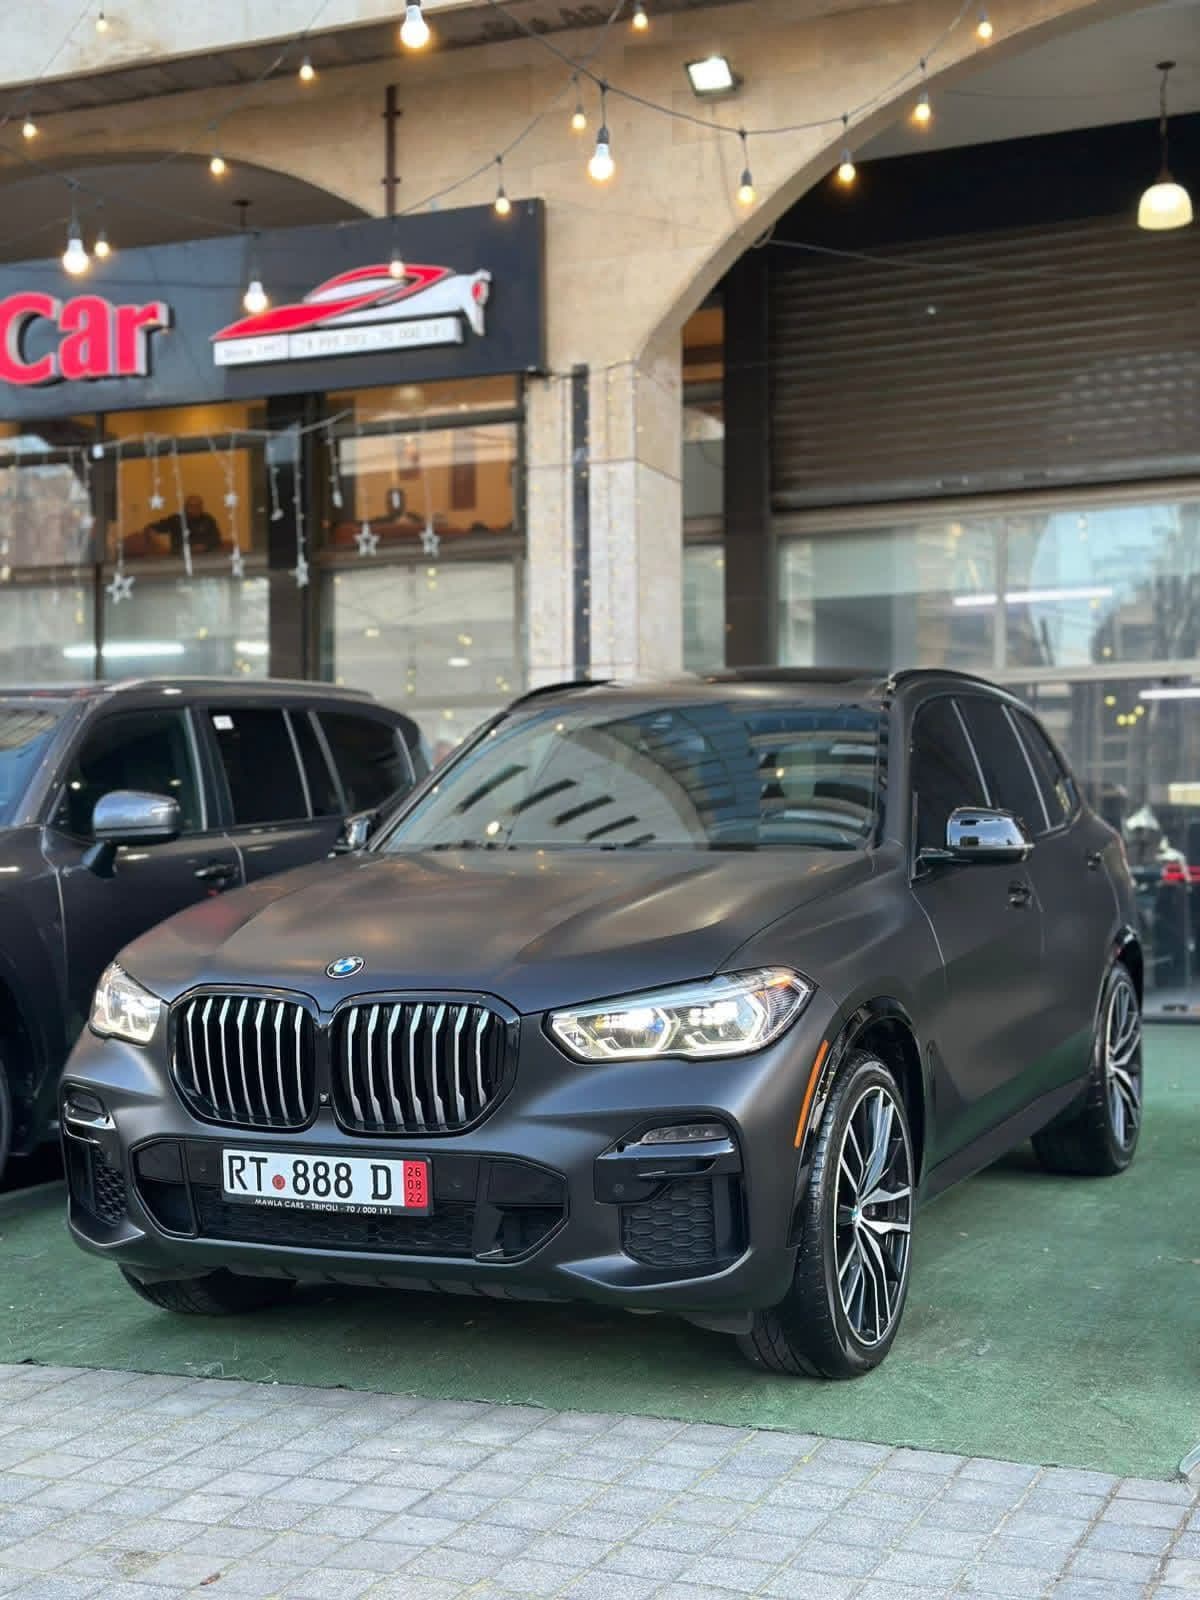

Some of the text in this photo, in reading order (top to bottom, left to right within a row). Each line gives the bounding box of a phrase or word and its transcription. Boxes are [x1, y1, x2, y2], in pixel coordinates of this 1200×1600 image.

[0, 291, 168, 385] Car
[227, 1155, 392, 1201] RT 888 D
[407, 1166, 422, 1178] 26
[407, 1179, 422, 1190] 08
[407, 1191, 423, 1203] 22
[255, 1199, 283, 1208] MAWLA
[284, 1200, 304, 1209] CARS
[311, 1202, 339, 1212] TRIPOLI
[346, 1205, 356, 1213] 70
[362, 1206, 377, 1215] 000
